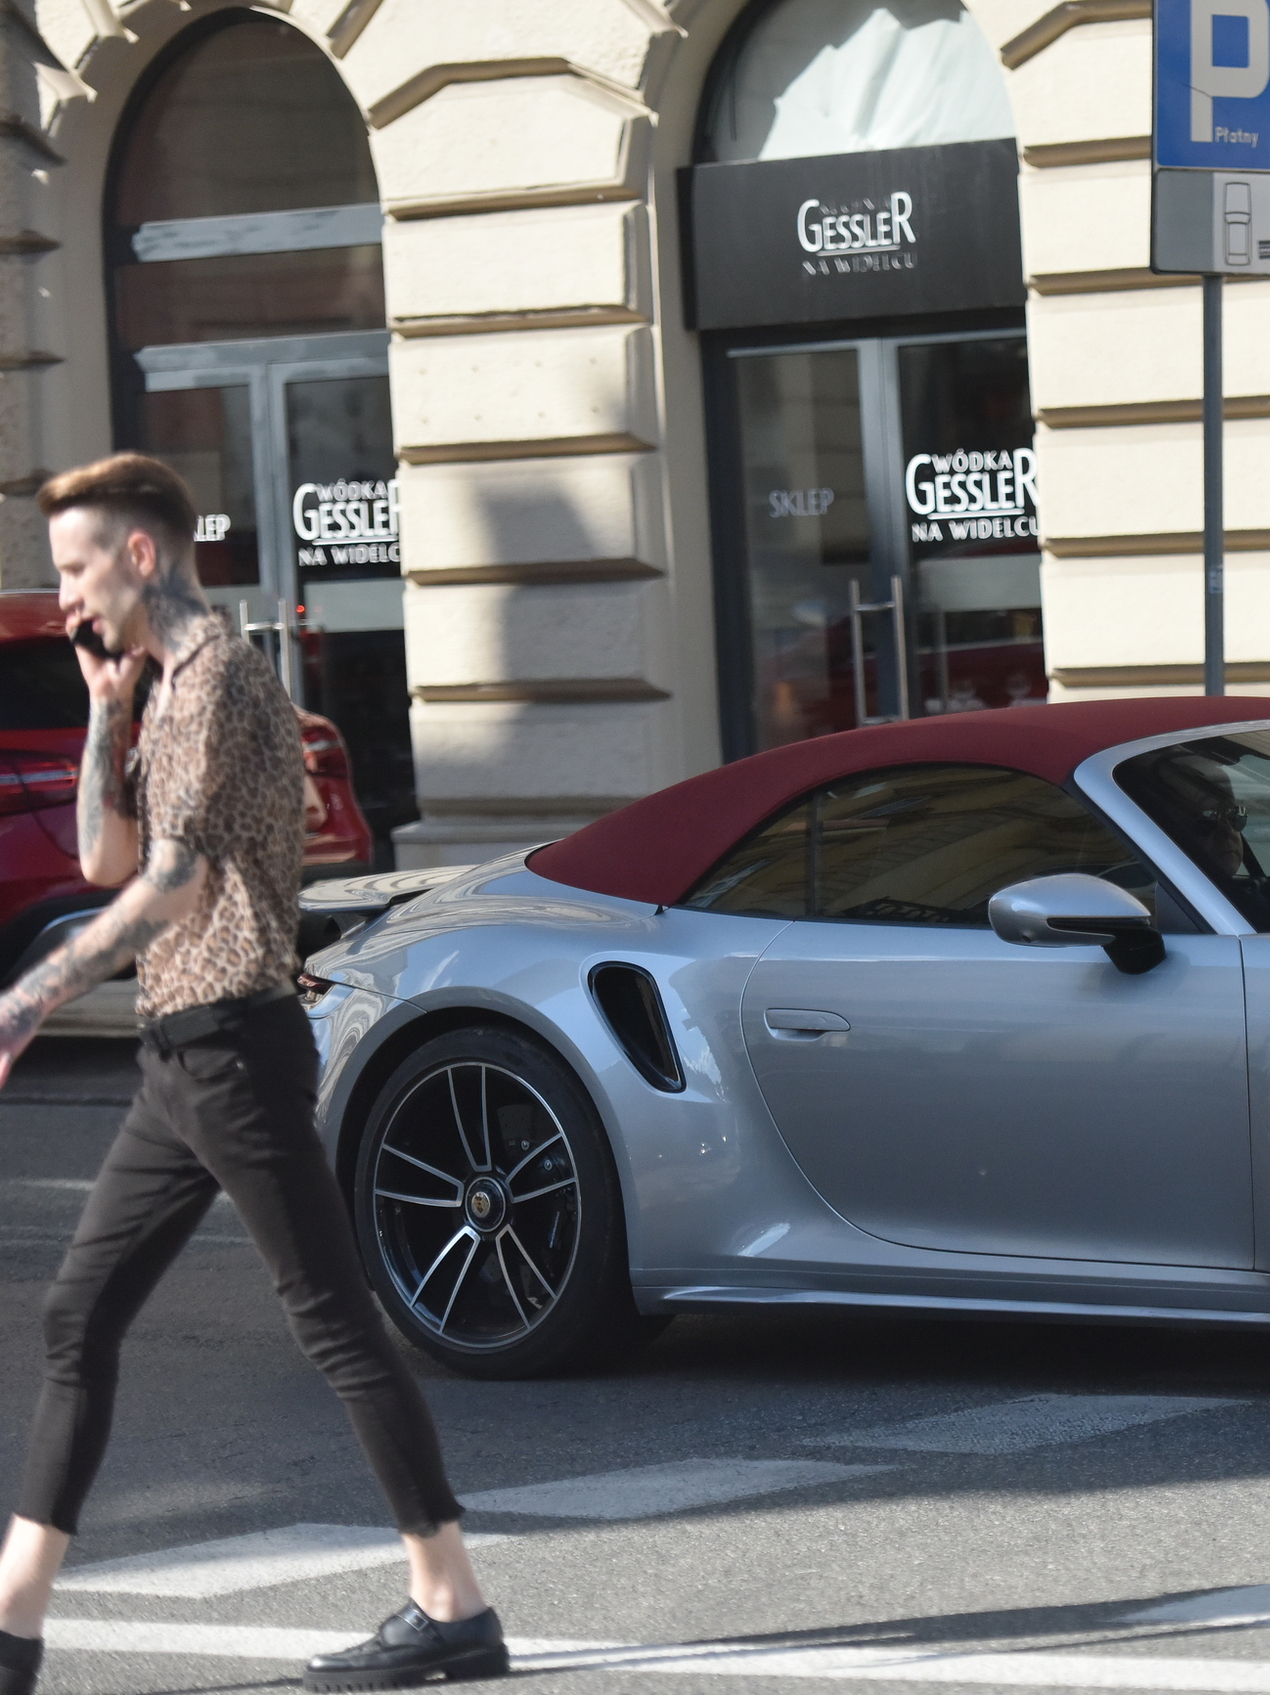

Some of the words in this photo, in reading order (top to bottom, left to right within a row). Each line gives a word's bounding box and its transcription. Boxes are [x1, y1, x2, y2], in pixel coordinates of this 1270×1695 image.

[1190, 0, 1270, 142] P
[797, 191, 917, 252] GESSLER
[931, 448, 1013, 473] WÓDKA
[316, 478, 388, 501] WÓDKA
[905, 447, 1040, 515] GESSLER
[768, 487, 835, 518] SKLEP
[193, 513, 232, 542] LEP
[911, 521, 943, 542] NA
[299, 546, 327, 566] NA
[330, 542, 400, 565] WIDELC
